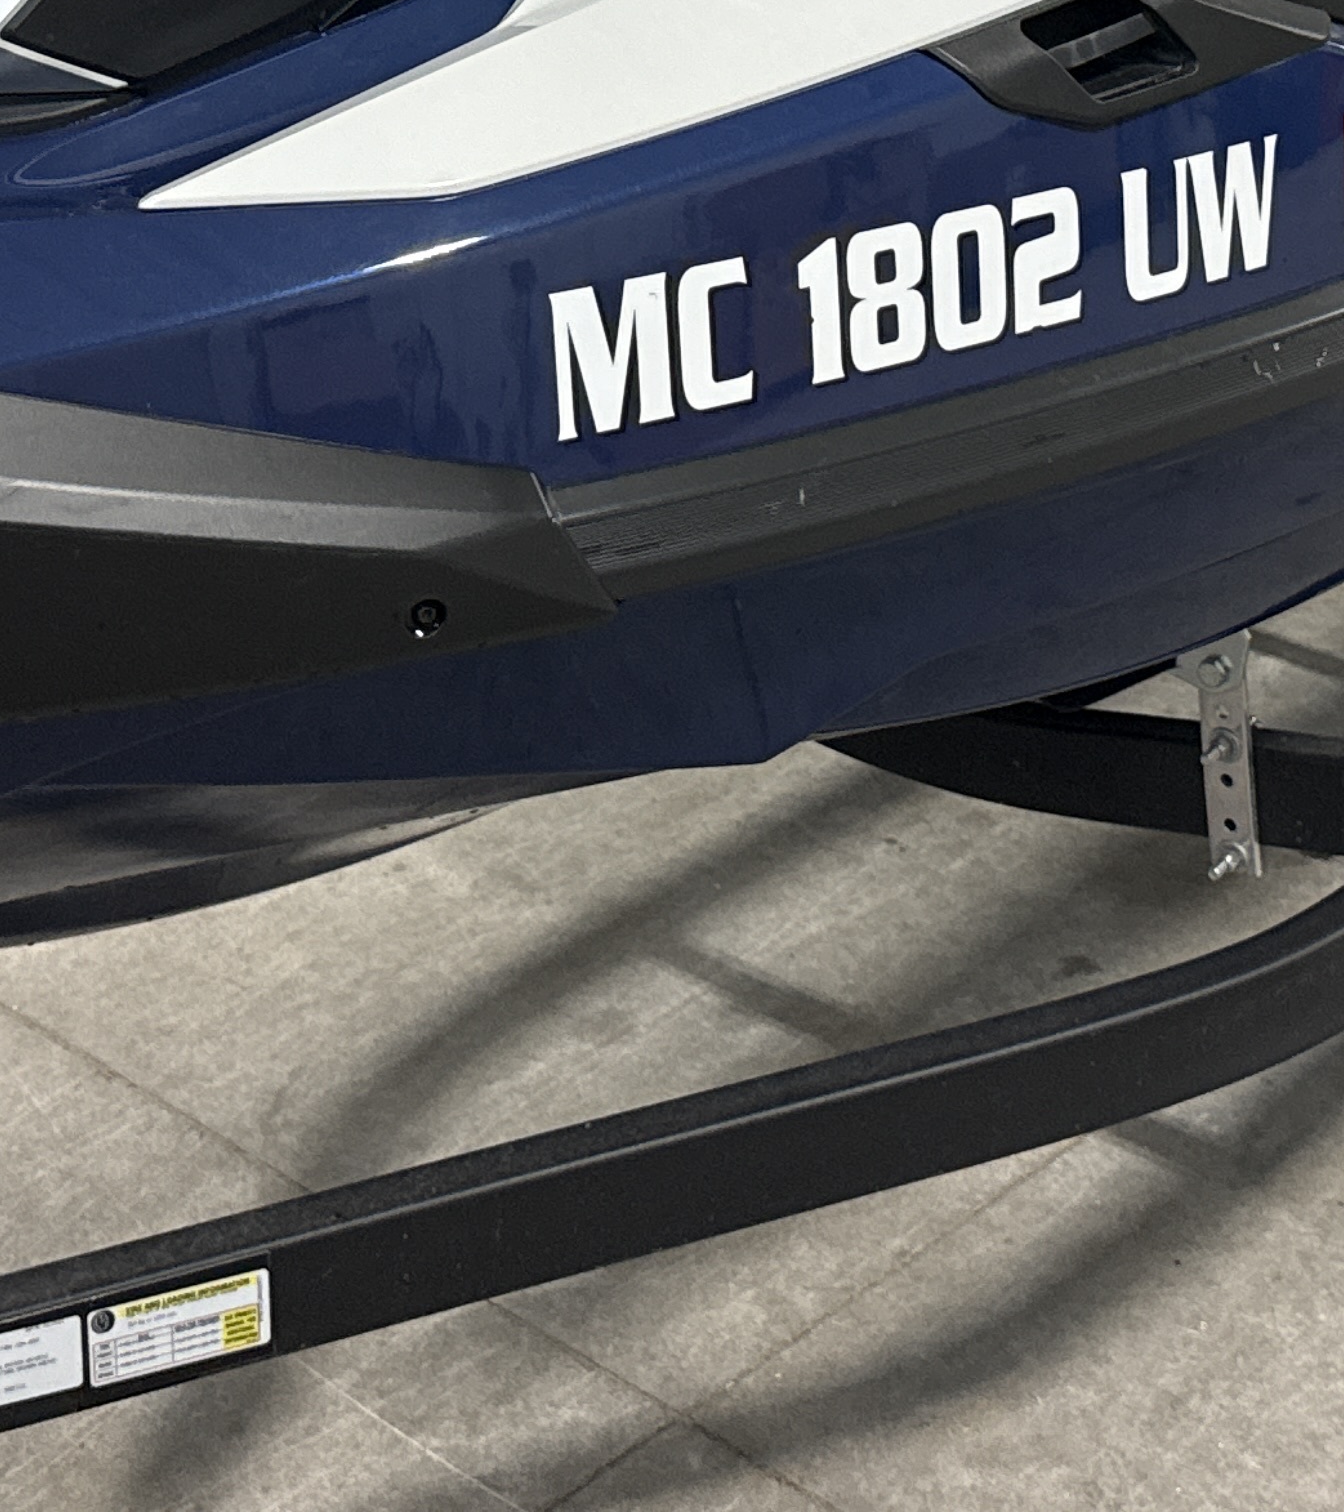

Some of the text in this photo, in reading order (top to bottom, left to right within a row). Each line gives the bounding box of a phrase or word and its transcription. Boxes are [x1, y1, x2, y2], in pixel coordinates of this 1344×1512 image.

[548, 134, 1278, 443] MC 1802 UW
